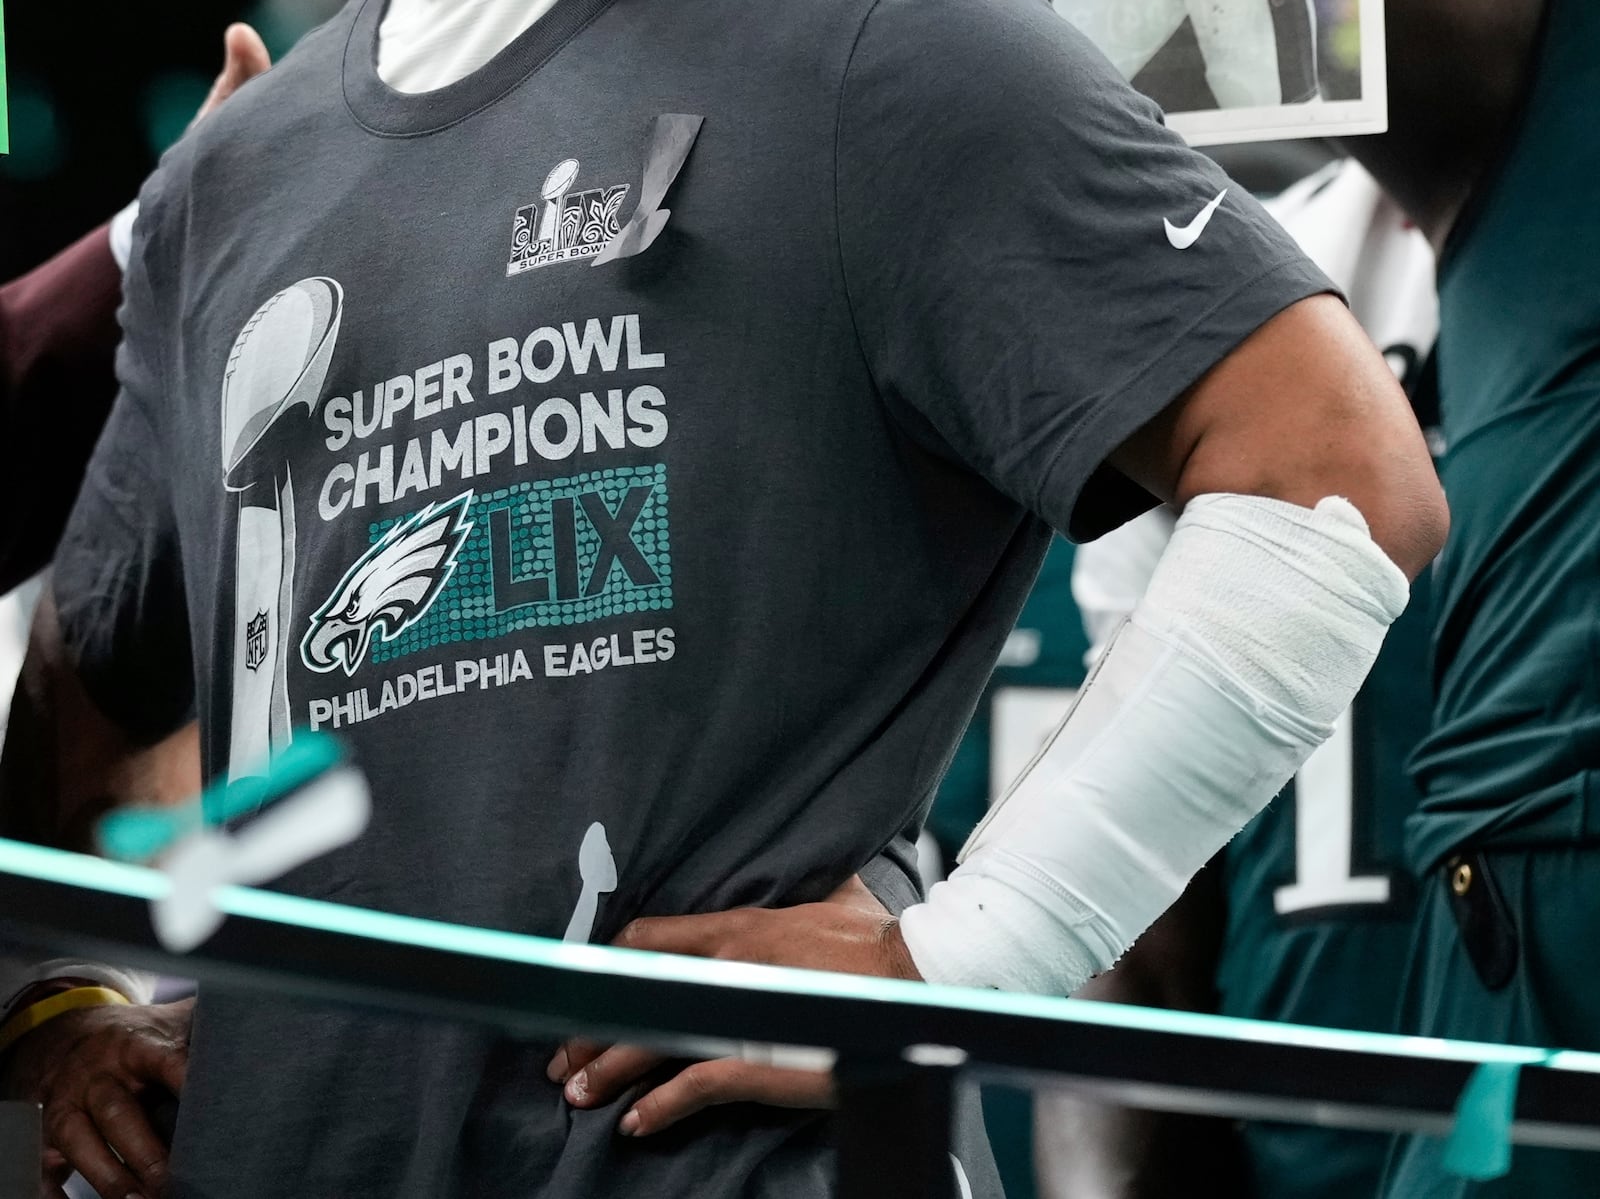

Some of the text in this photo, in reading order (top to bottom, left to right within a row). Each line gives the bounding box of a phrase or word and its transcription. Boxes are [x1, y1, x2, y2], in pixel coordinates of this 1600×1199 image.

[519, 251, 564, 270] SUPER
[324, 314, 666, 452] SUPER BOWL
[317, 385, 669, 522] CHAMPIONS
[486, 484, 665, 614] LIX
[247, 634, 265, 665] NFL
[308, 627, 676, 732] PHILADELPHIA EAGLES
